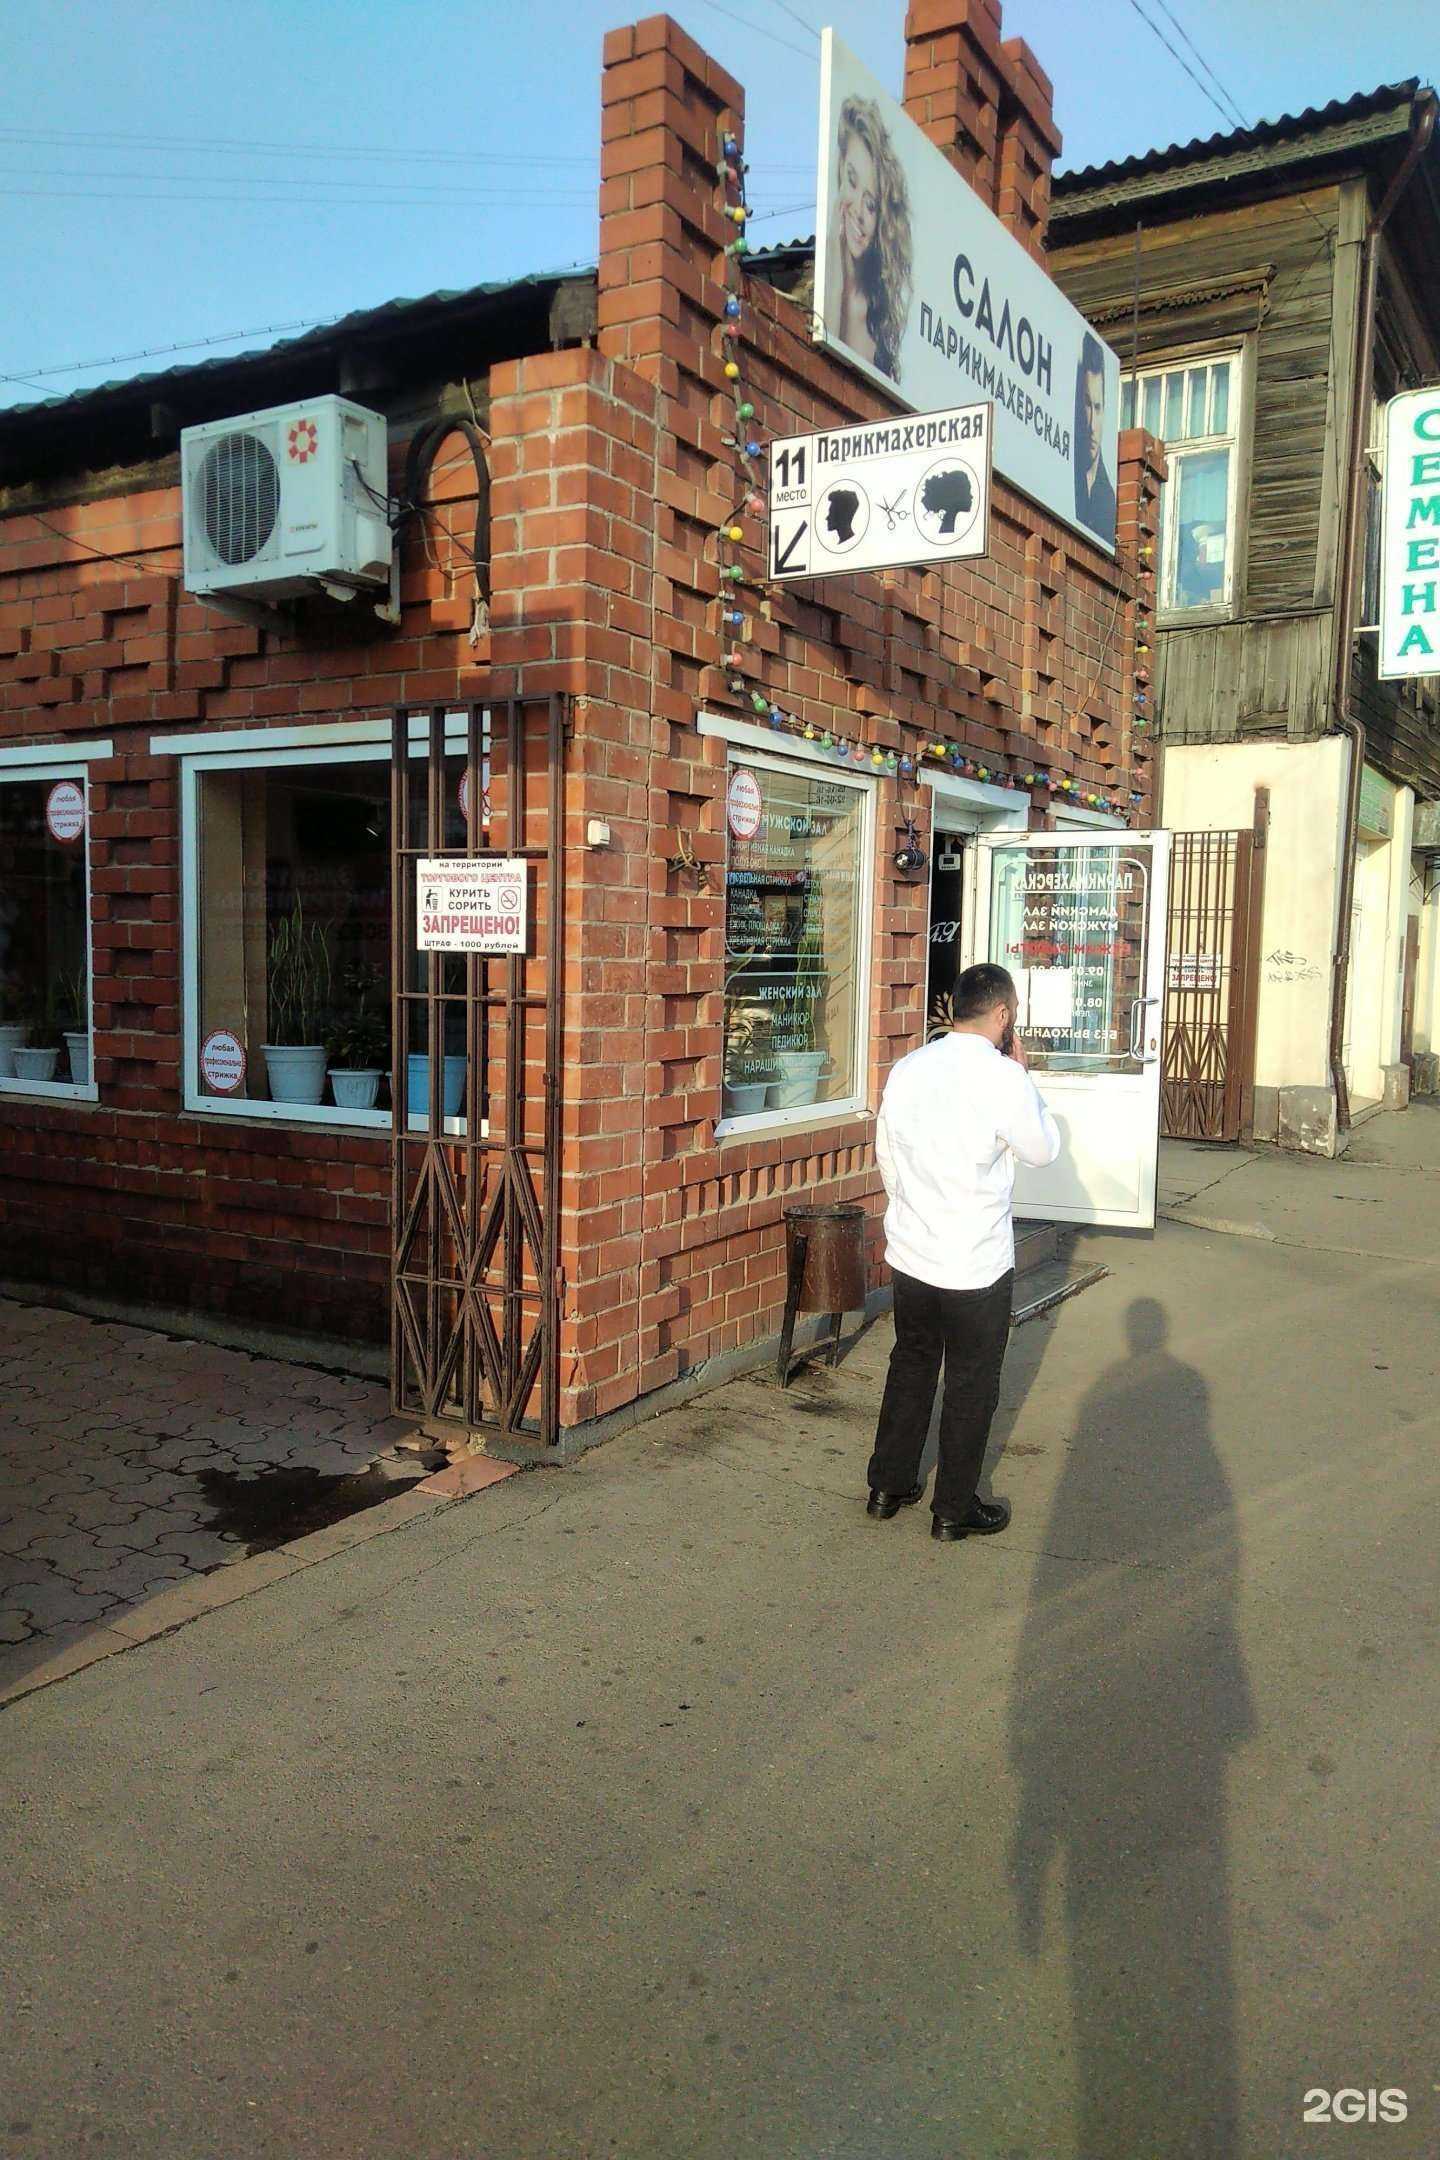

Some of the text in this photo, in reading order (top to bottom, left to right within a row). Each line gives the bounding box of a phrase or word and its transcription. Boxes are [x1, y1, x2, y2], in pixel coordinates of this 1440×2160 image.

[953, 253, 1052, 396] САЛОН
[919, 301, 1070, 460] ПАРИКМАХЕРСКАЯ
[817, 412, 984, 464] Парикмахерская
[775, 446, 806, 487] 11
[775, 487, 807, 504] место
[1397, 408, 1440, 657] СЕМЕНА
[762, 812, 828, 836] МУЖСКОЙ ЗАЛ
[449, 889, 491, 898] КУРИТЬ
[448, 901, 492, 911] СОРИТЬ
[423, 915, 520, 938] ЗАПРЕЩЕНО!
[424, 939, 452, 947] ШТРАФ
[460, 940, 482, 948] 1000
[484, 942, 519, 950] рублей
[759, 982, 823, 1001] ЖЕНСКИЙ ЗАЛ
[771, 1012, 810, 1027] МАНИКЮР
[771, 1033, 809, 1049] ПЕДИКЮР
